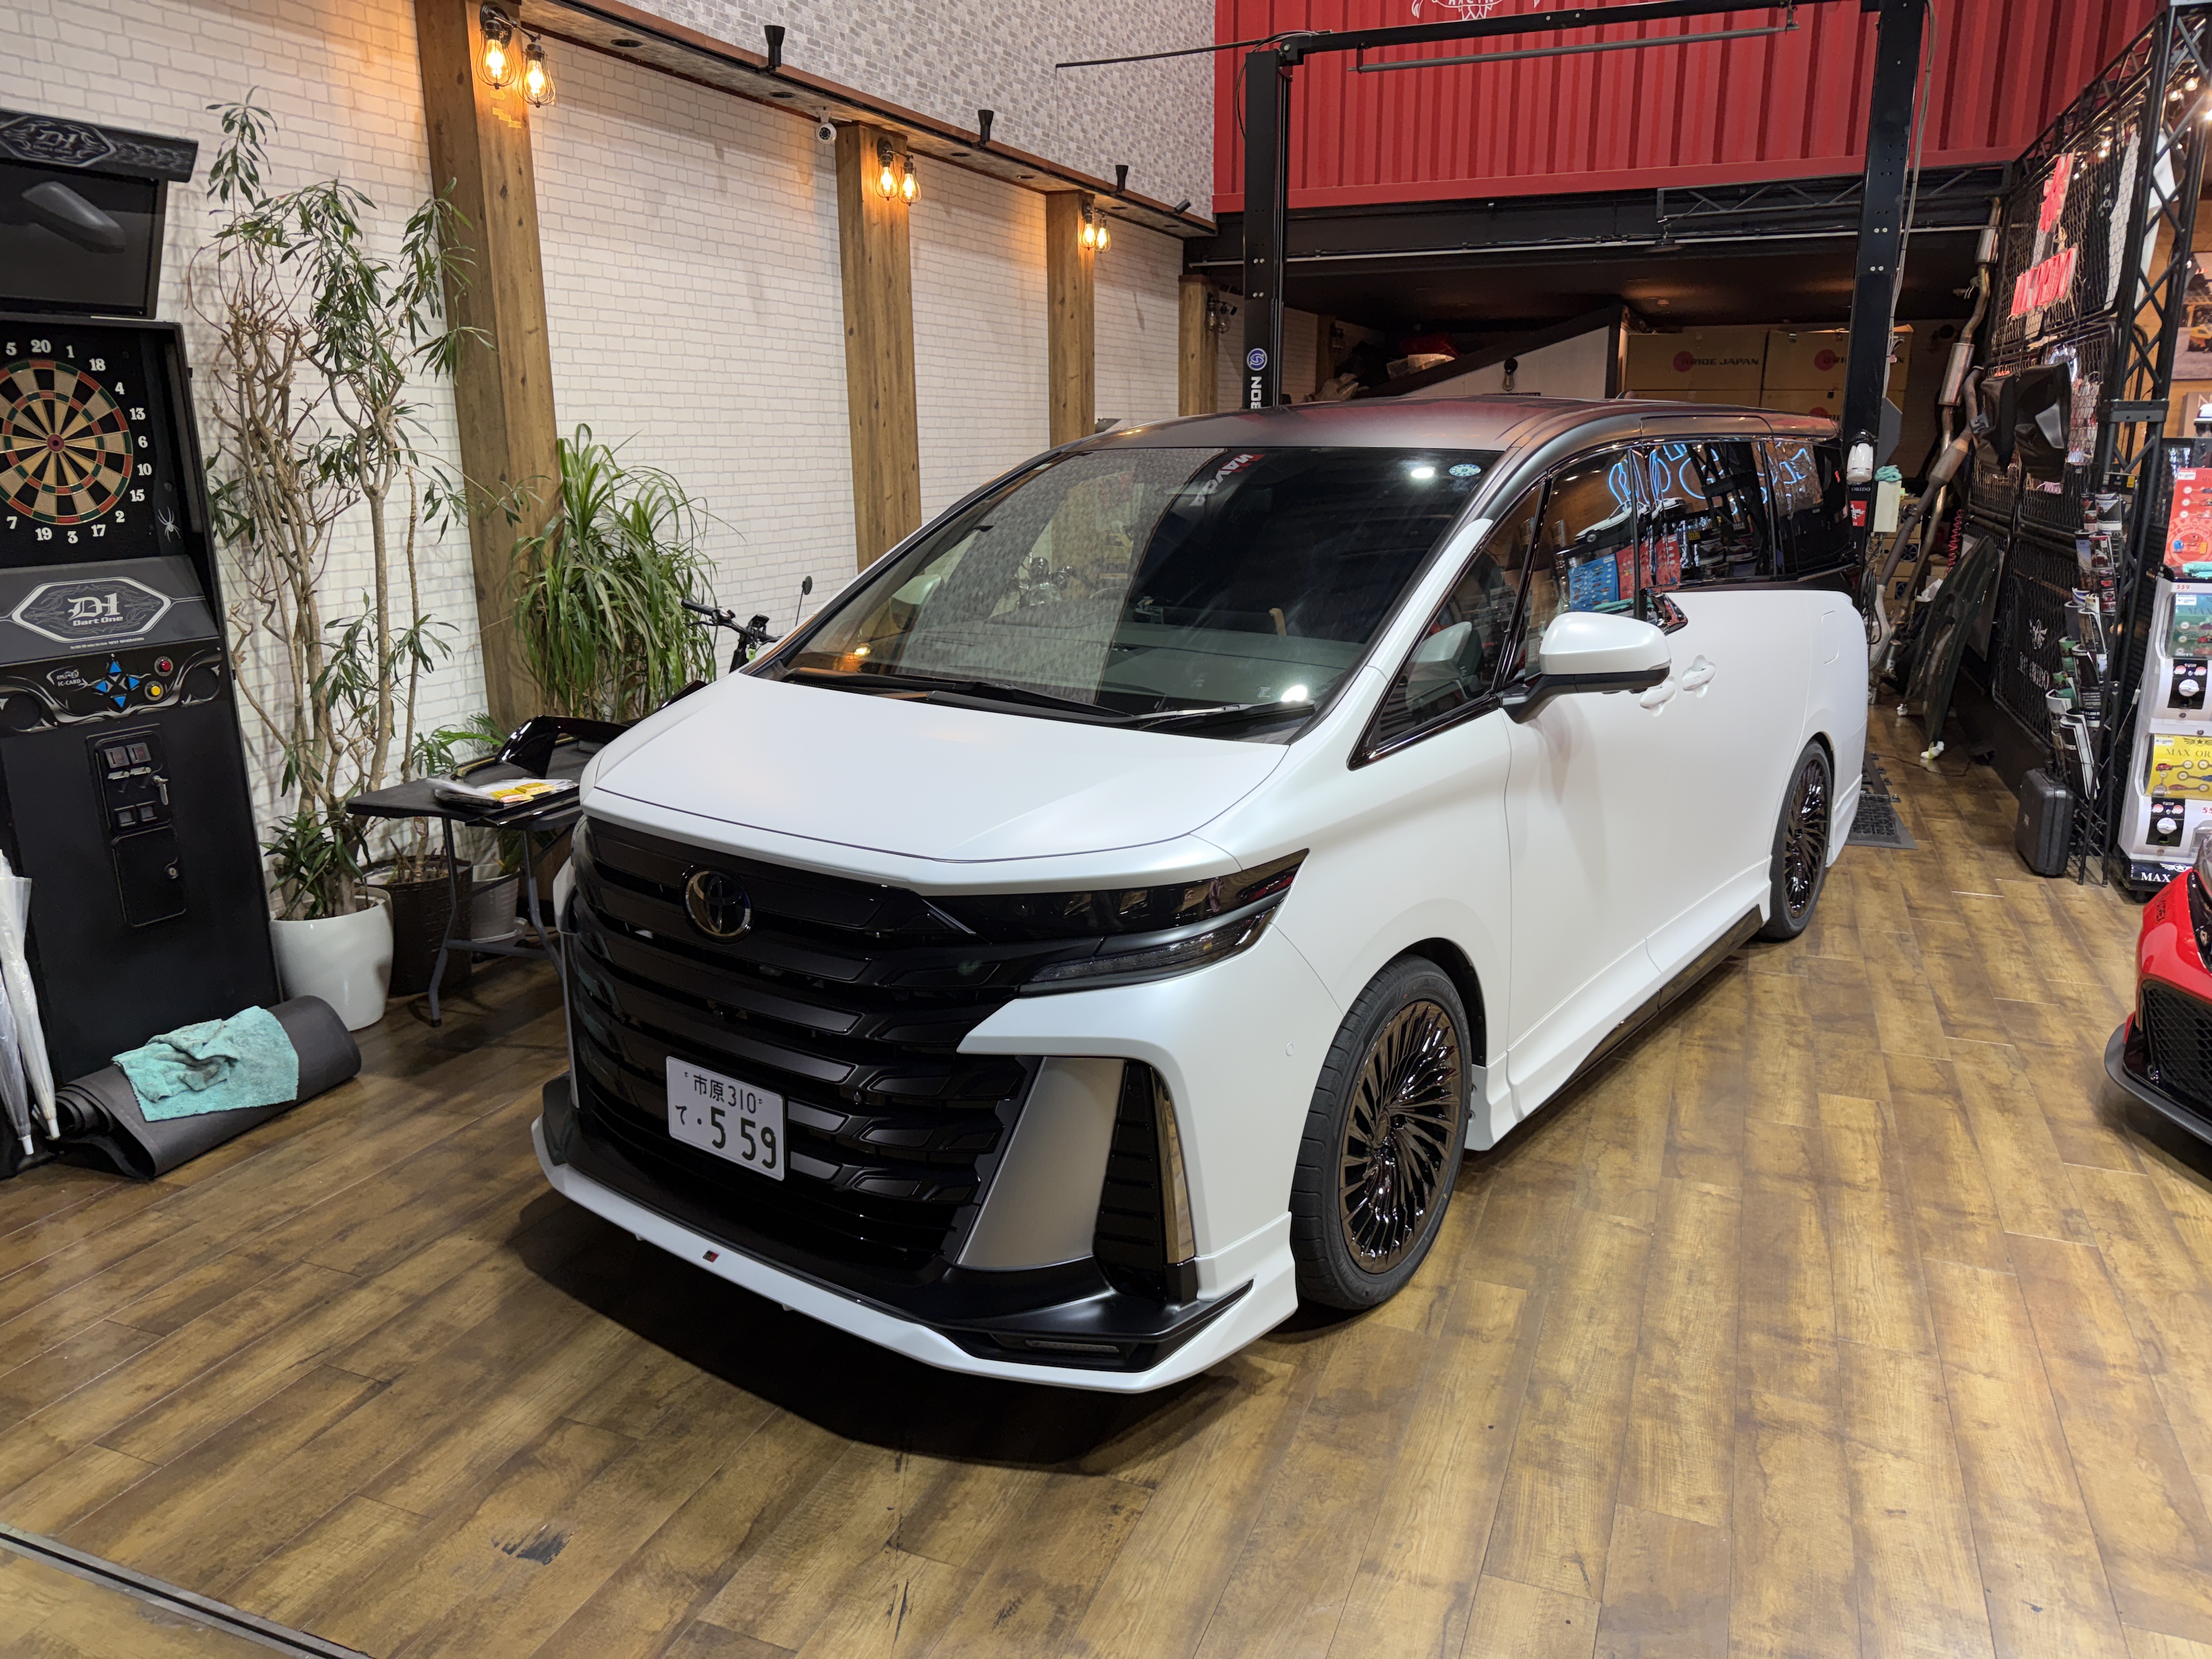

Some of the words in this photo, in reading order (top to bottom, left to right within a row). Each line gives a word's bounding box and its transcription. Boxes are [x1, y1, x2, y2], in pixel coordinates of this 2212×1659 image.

[5, 342, 18, 356] 5
[31, 340, 52, 353] 20
[66, 346, 75, 358] 1
[89, 358, 106, 371] 18
[115, 382, 125, 394] 4
[129, 408, 145, 420] 13
[138, 436, 148, 448] 6
[137, 464, 152, 476] 10
[129, 489, 145, 501] 15
[7, 516, 18, 529] 7
[115, 510, 125, 523] 2
[35, 528, 53, 541] 19
[91, 524, 106, 537] 17
[67, 531, 78, 544] 3
[73, 618, 99, 627] Dart
[100, 616, 123, 624] One
[58, 678, 82, 686] IC-CARD
[2165, 748, 2191, 757] MAX
[2141, 872, 2171, 883] MAX
[675, 1104, 687, 1125] て
